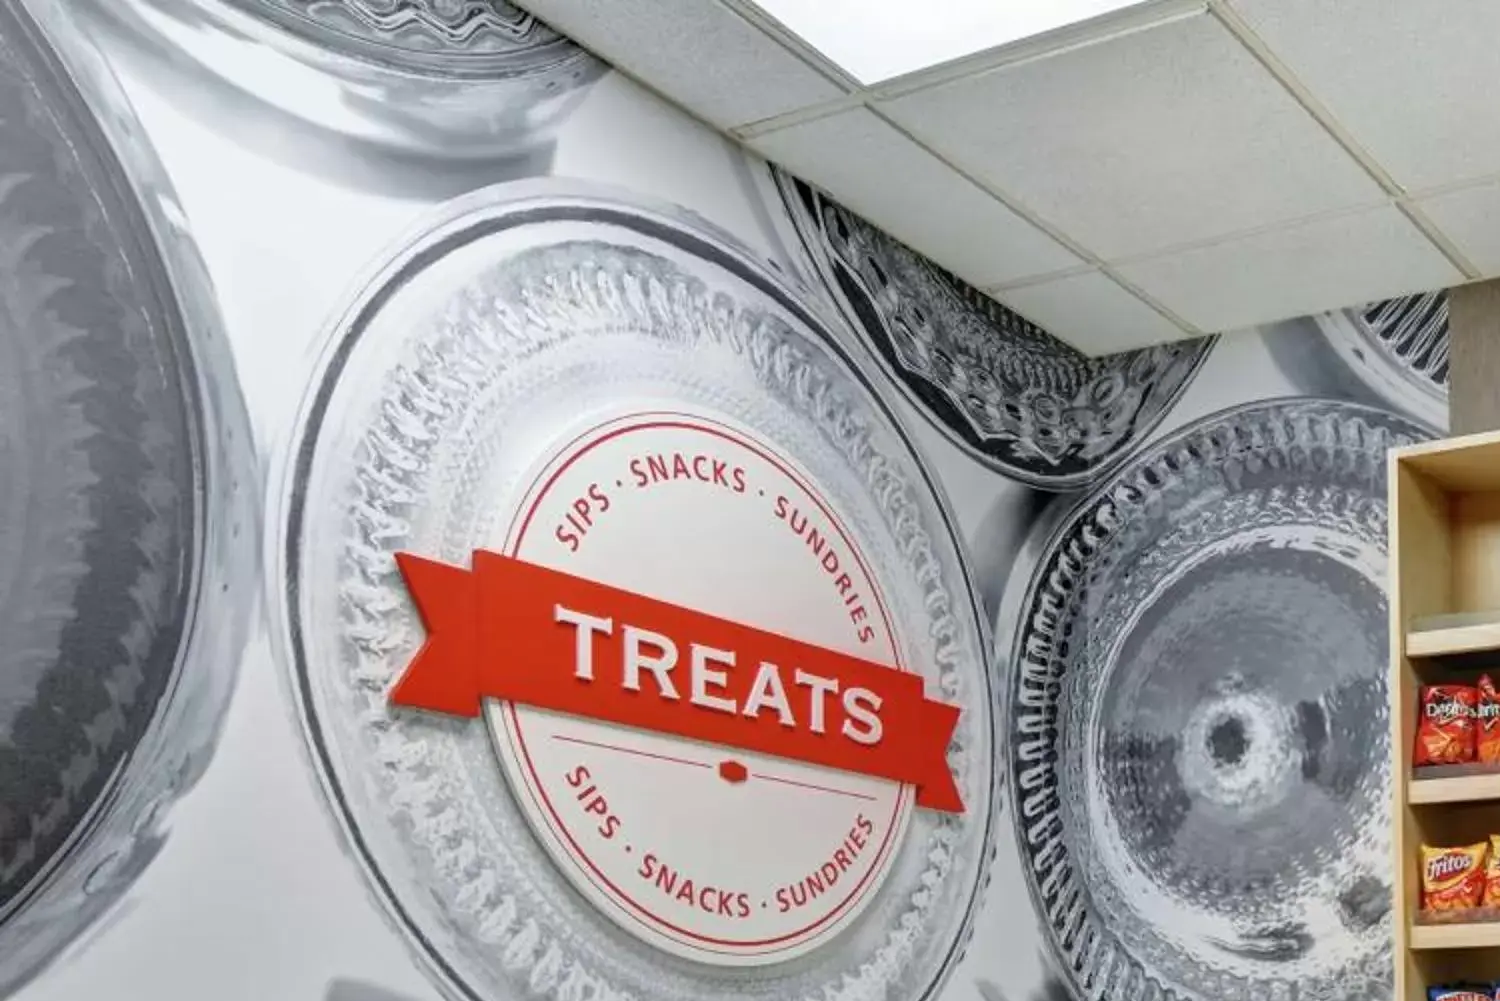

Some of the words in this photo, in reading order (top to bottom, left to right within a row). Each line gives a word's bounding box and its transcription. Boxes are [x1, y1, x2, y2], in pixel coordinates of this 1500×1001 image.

[554, 481, 610, 552] SIPS
[629, 454, 747, 494] SNACKS
[774, 494, 875, 645] SUNDRIES
[553, 602, 885, 747] TREATS
[565, 764, 622, 839] SIPS
[637, 853, 750, 918] SNACKS
[775, 812, 874, 914] SUNDRIES
[1427, 854, 1473, 880] Fritos
